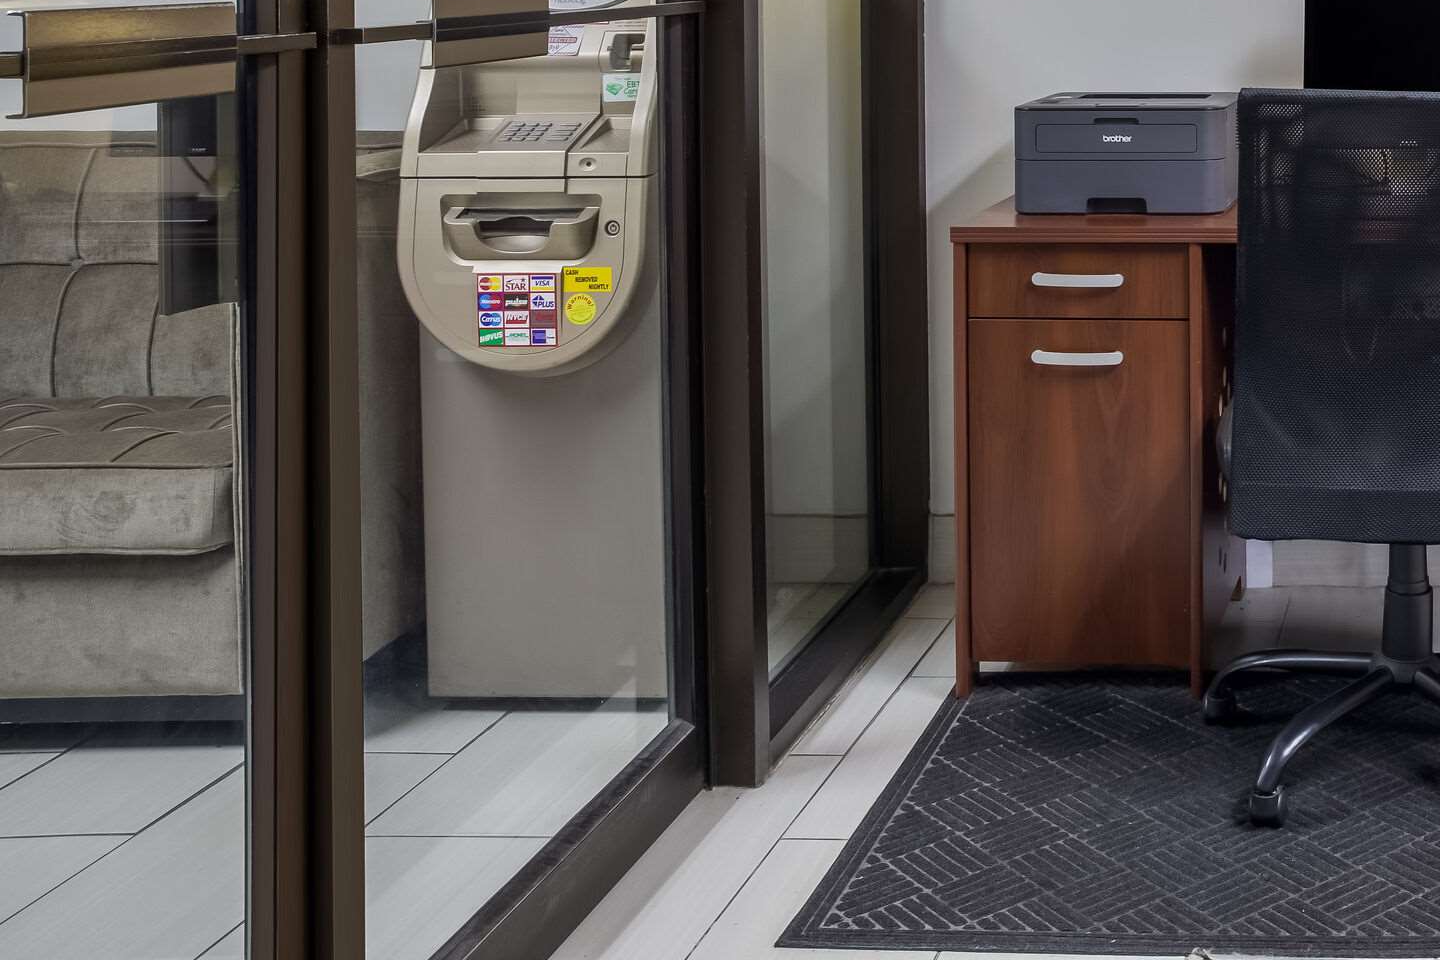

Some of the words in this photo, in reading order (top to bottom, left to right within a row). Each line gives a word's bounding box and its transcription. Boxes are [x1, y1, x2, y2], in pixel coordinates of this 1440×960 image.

[1102, 134, 1132, 143] brother
[505, 282, 527, 291] STAR
[537, 301, 555, 309] PLUS
